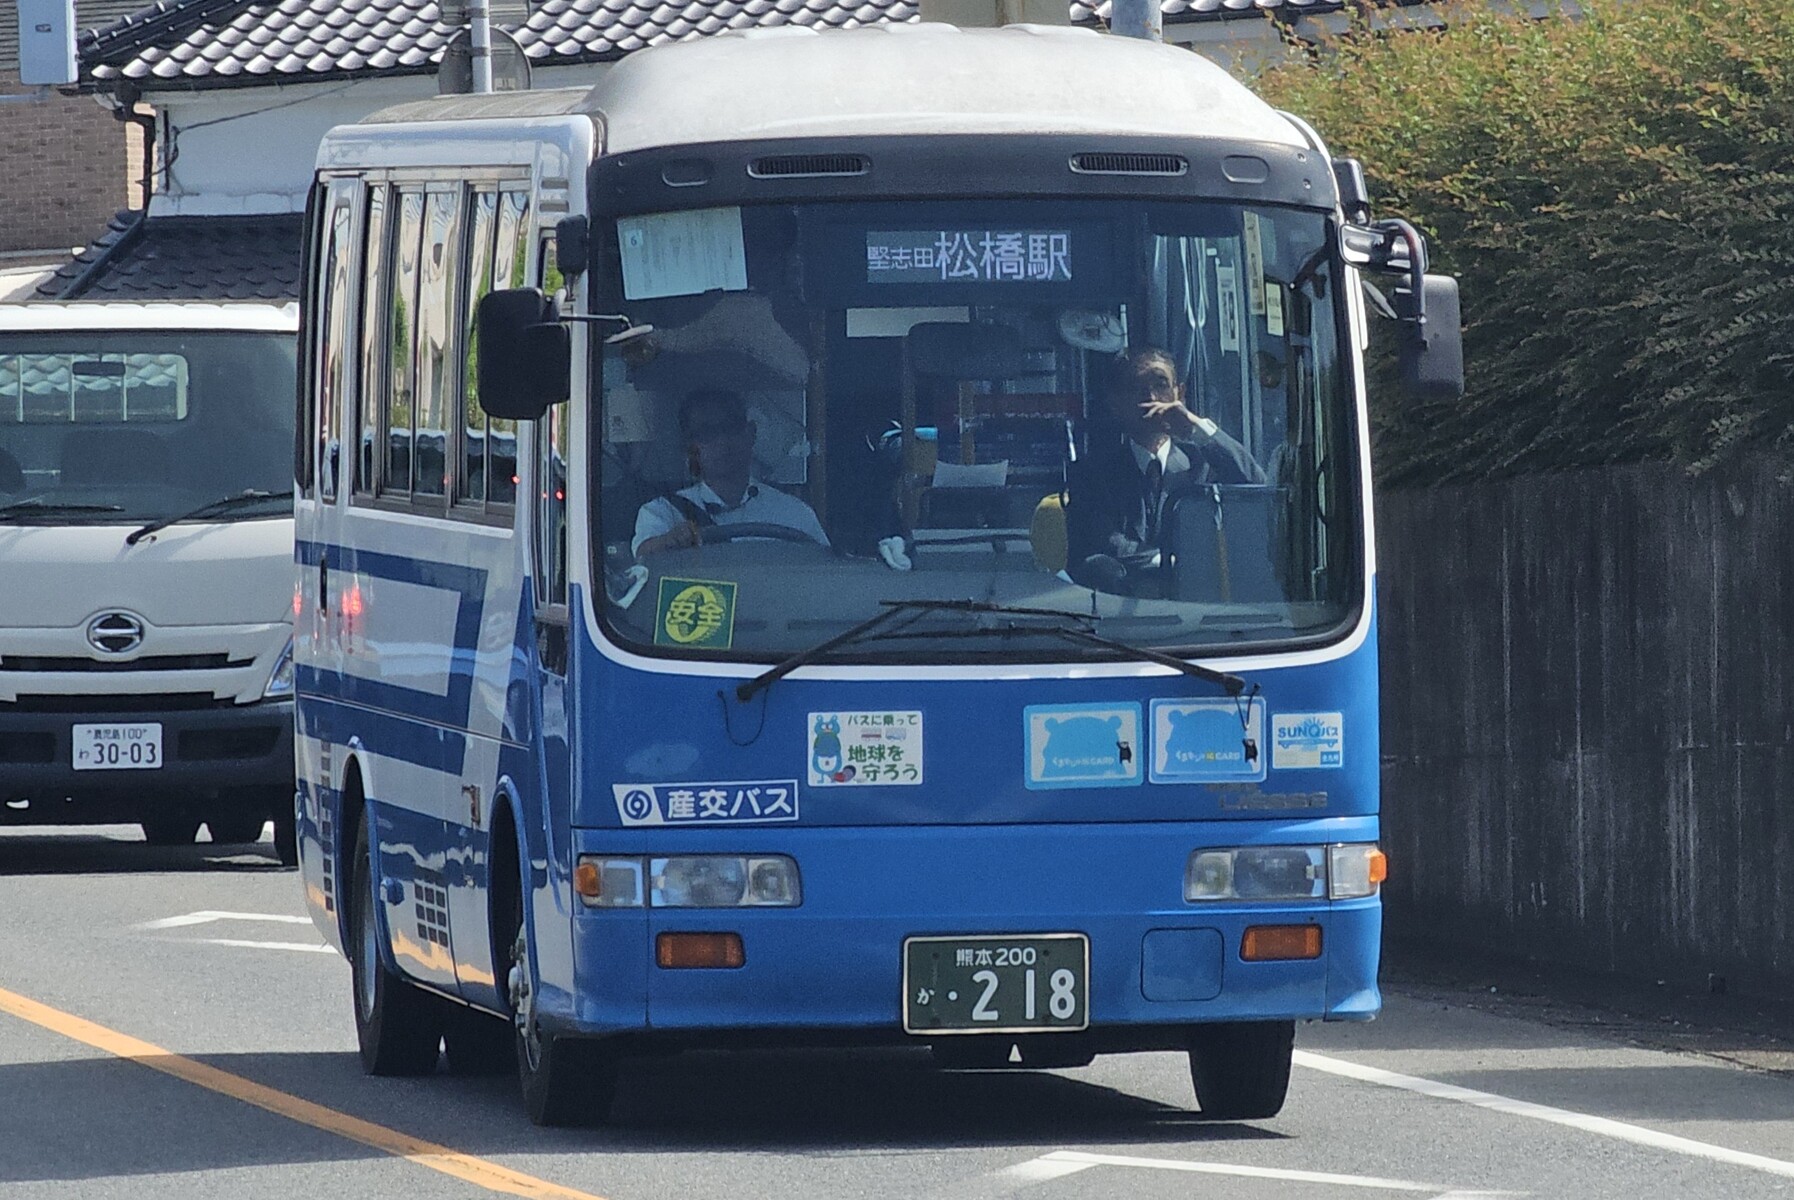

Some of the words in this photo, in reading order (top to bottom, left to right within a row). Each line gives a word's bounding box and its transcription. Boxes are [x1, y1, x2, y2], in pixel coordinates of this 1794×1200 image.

[935, 231, 1072, 280] 松橋駅
[669, 601, 723, 626] 安全
[848, 714, 918, 726] バスに乗って
[93, 742, 156, 765] 30-03
[848, 744, 904, 762] 地球を
[862, 763, 918, 781] 守ろう
[667, 787, 792, 819] 産交バス
[916, 987, 935, 1005] か
